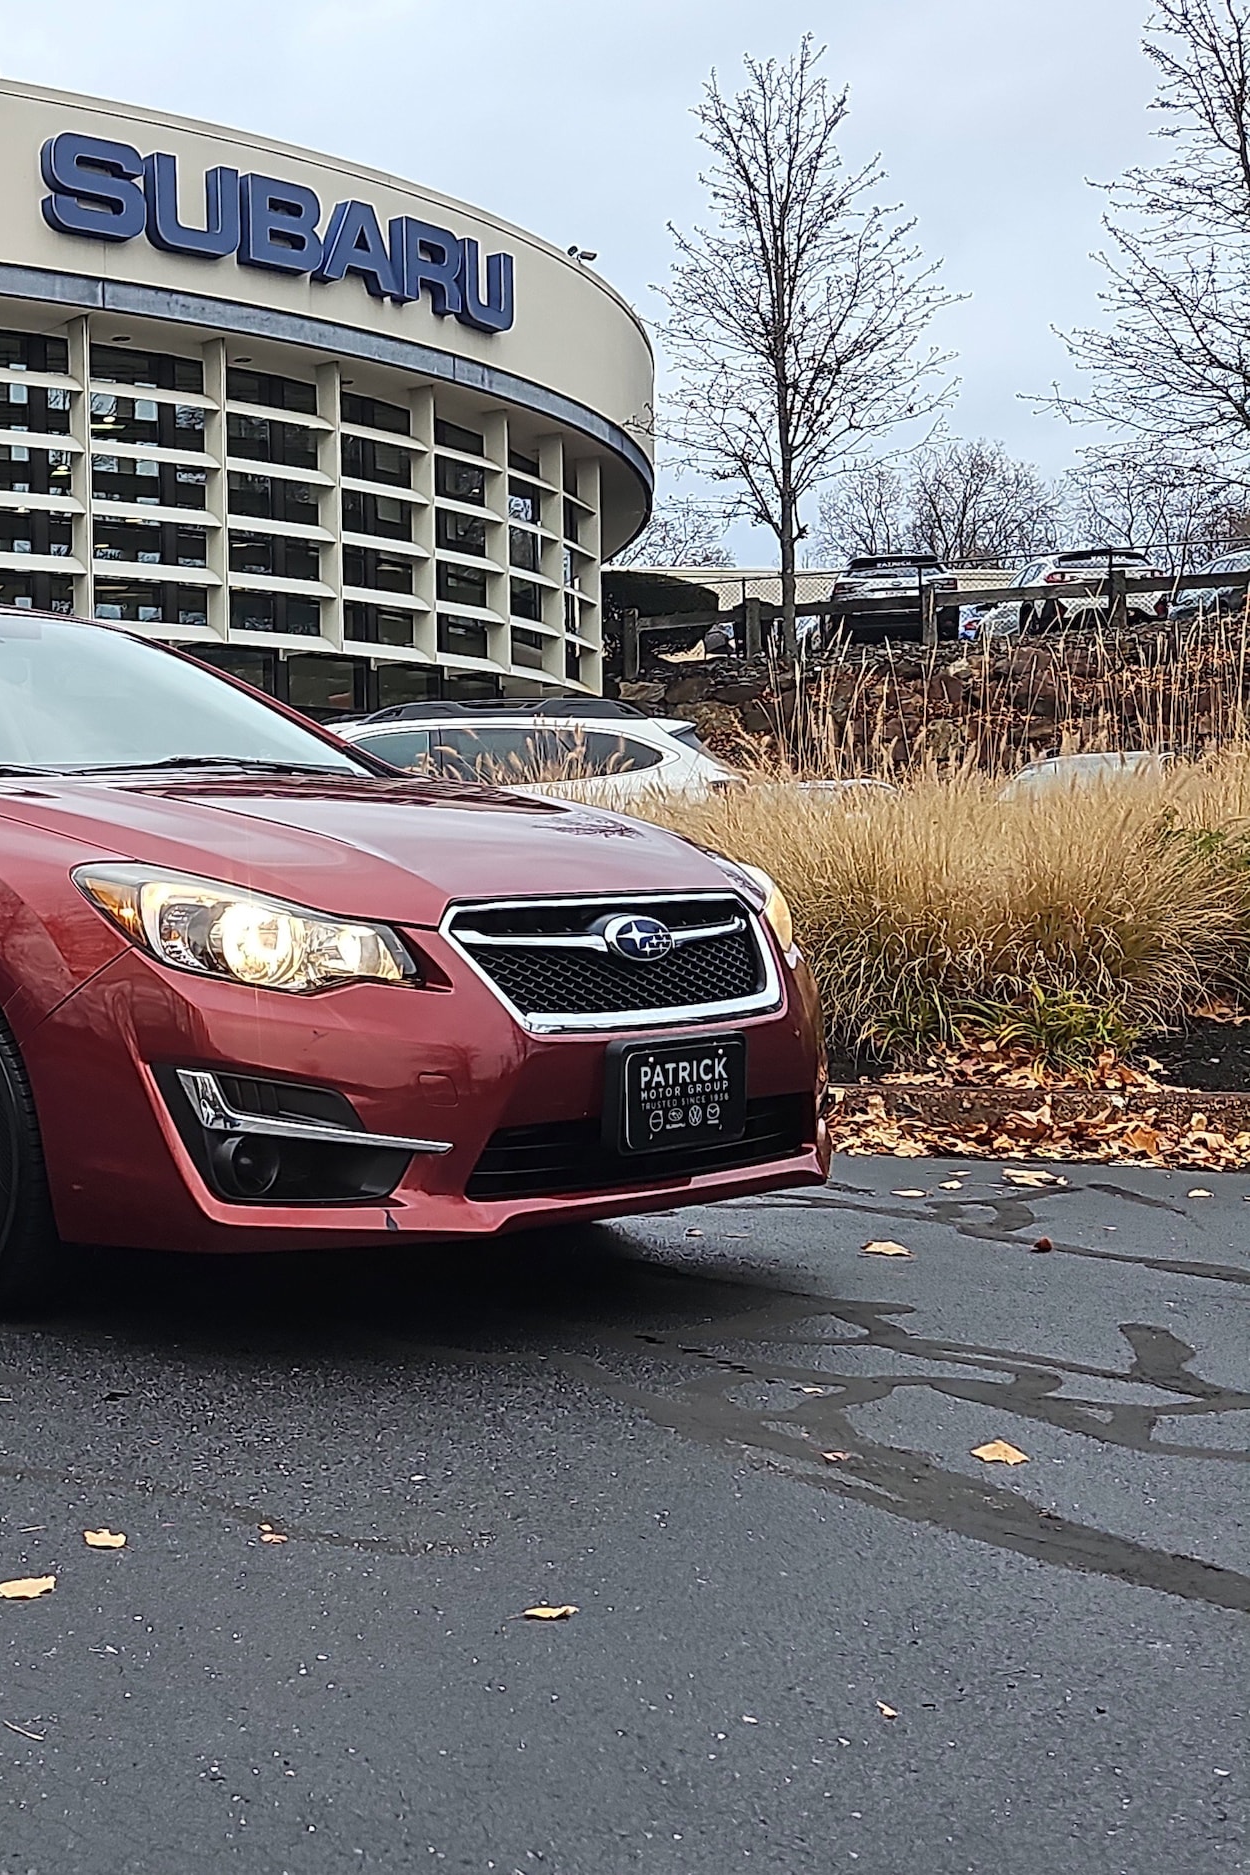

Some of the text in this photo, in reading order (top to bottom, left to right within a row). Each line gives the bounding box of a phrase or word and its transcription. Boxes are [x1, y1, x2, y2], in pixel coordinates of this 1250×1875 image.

[39, 132, 515, 335] SUBARU
[640, 1057, 728, 1089] PATRICK
[641, 1080, 729, 1101] MOTOR GROUP
[641, 1099, 678, 1110] TRUSTED
[681, 1095, 706, 1106] SINCE
